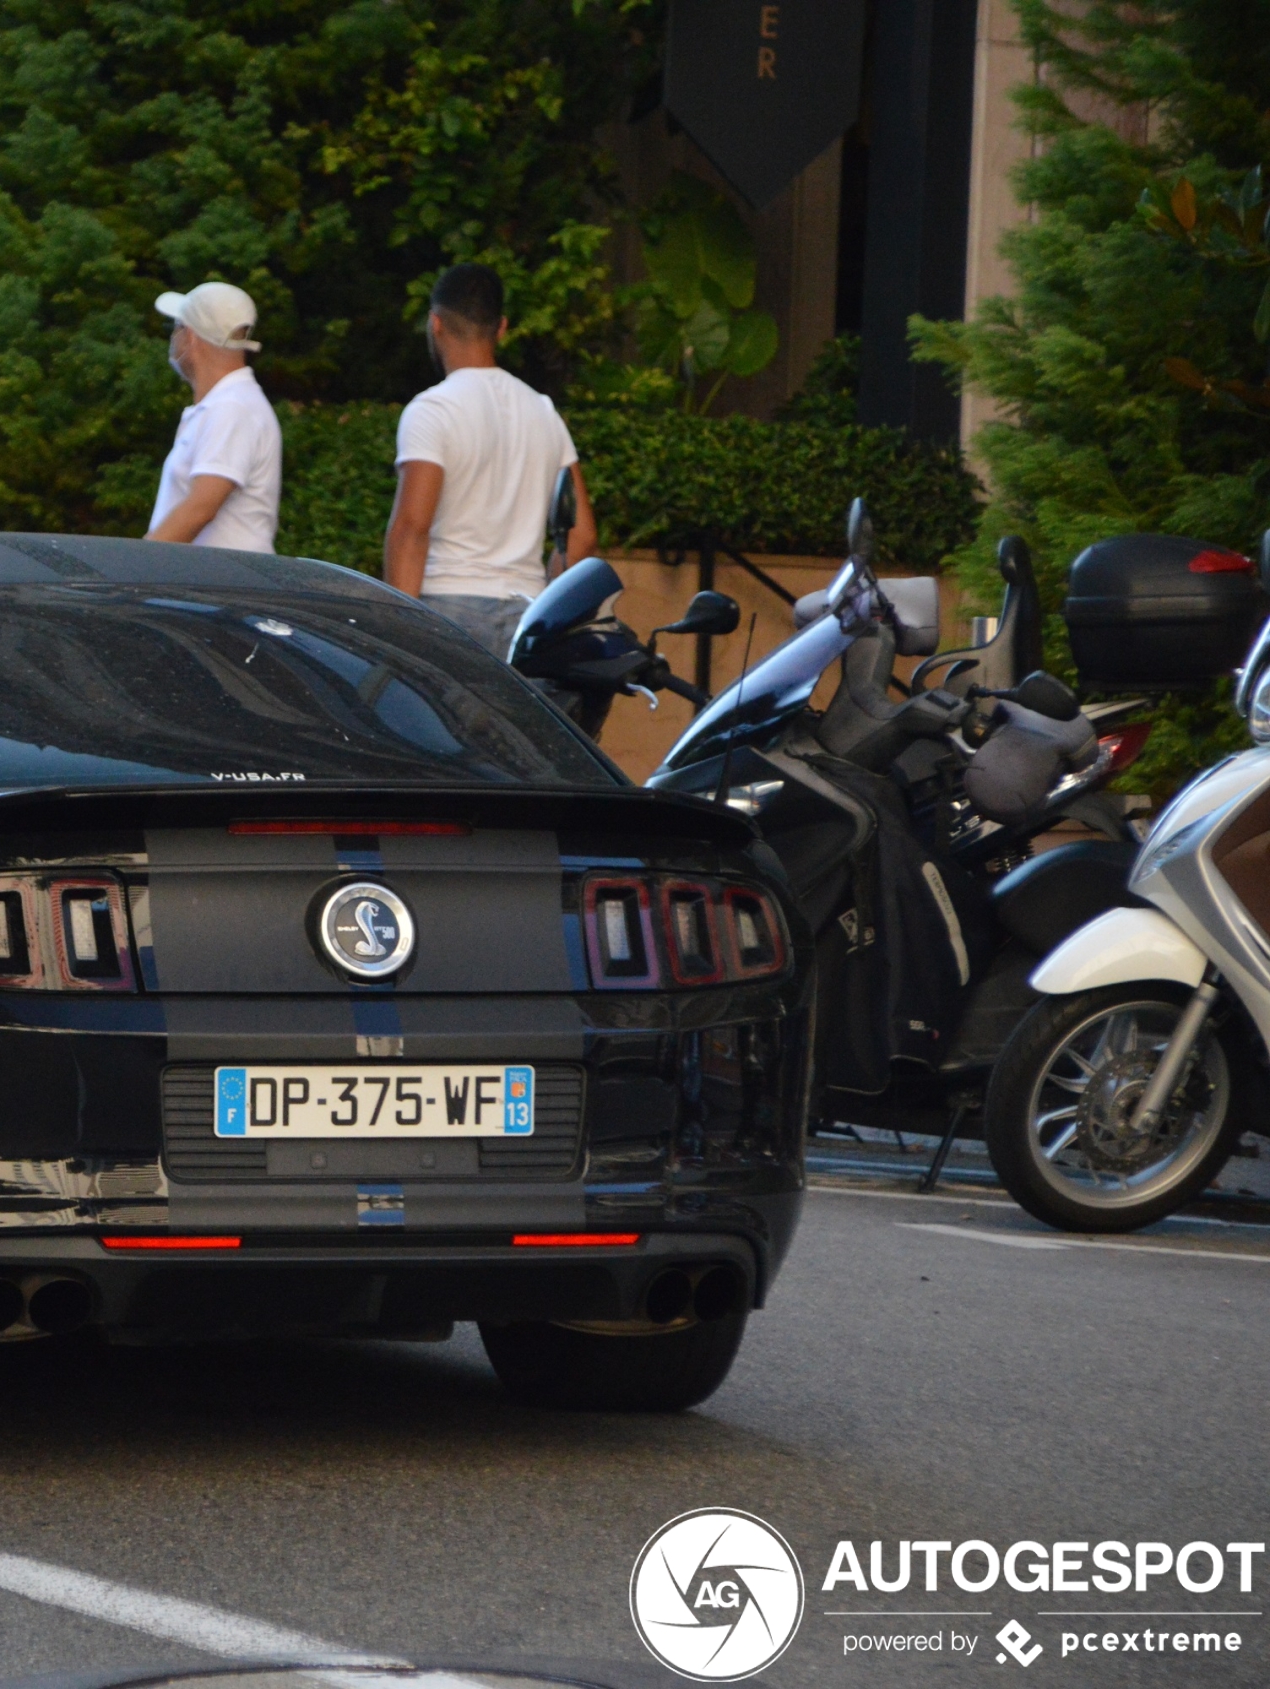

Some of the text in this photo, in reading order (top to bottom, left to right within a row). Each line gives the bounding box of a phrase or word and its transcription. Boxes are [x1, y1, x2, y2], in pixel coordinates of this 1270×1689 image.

[210, 772, 306, 781] V-USA.FR
[227, 1076, 529, 1127] F DP-375-WF 13
